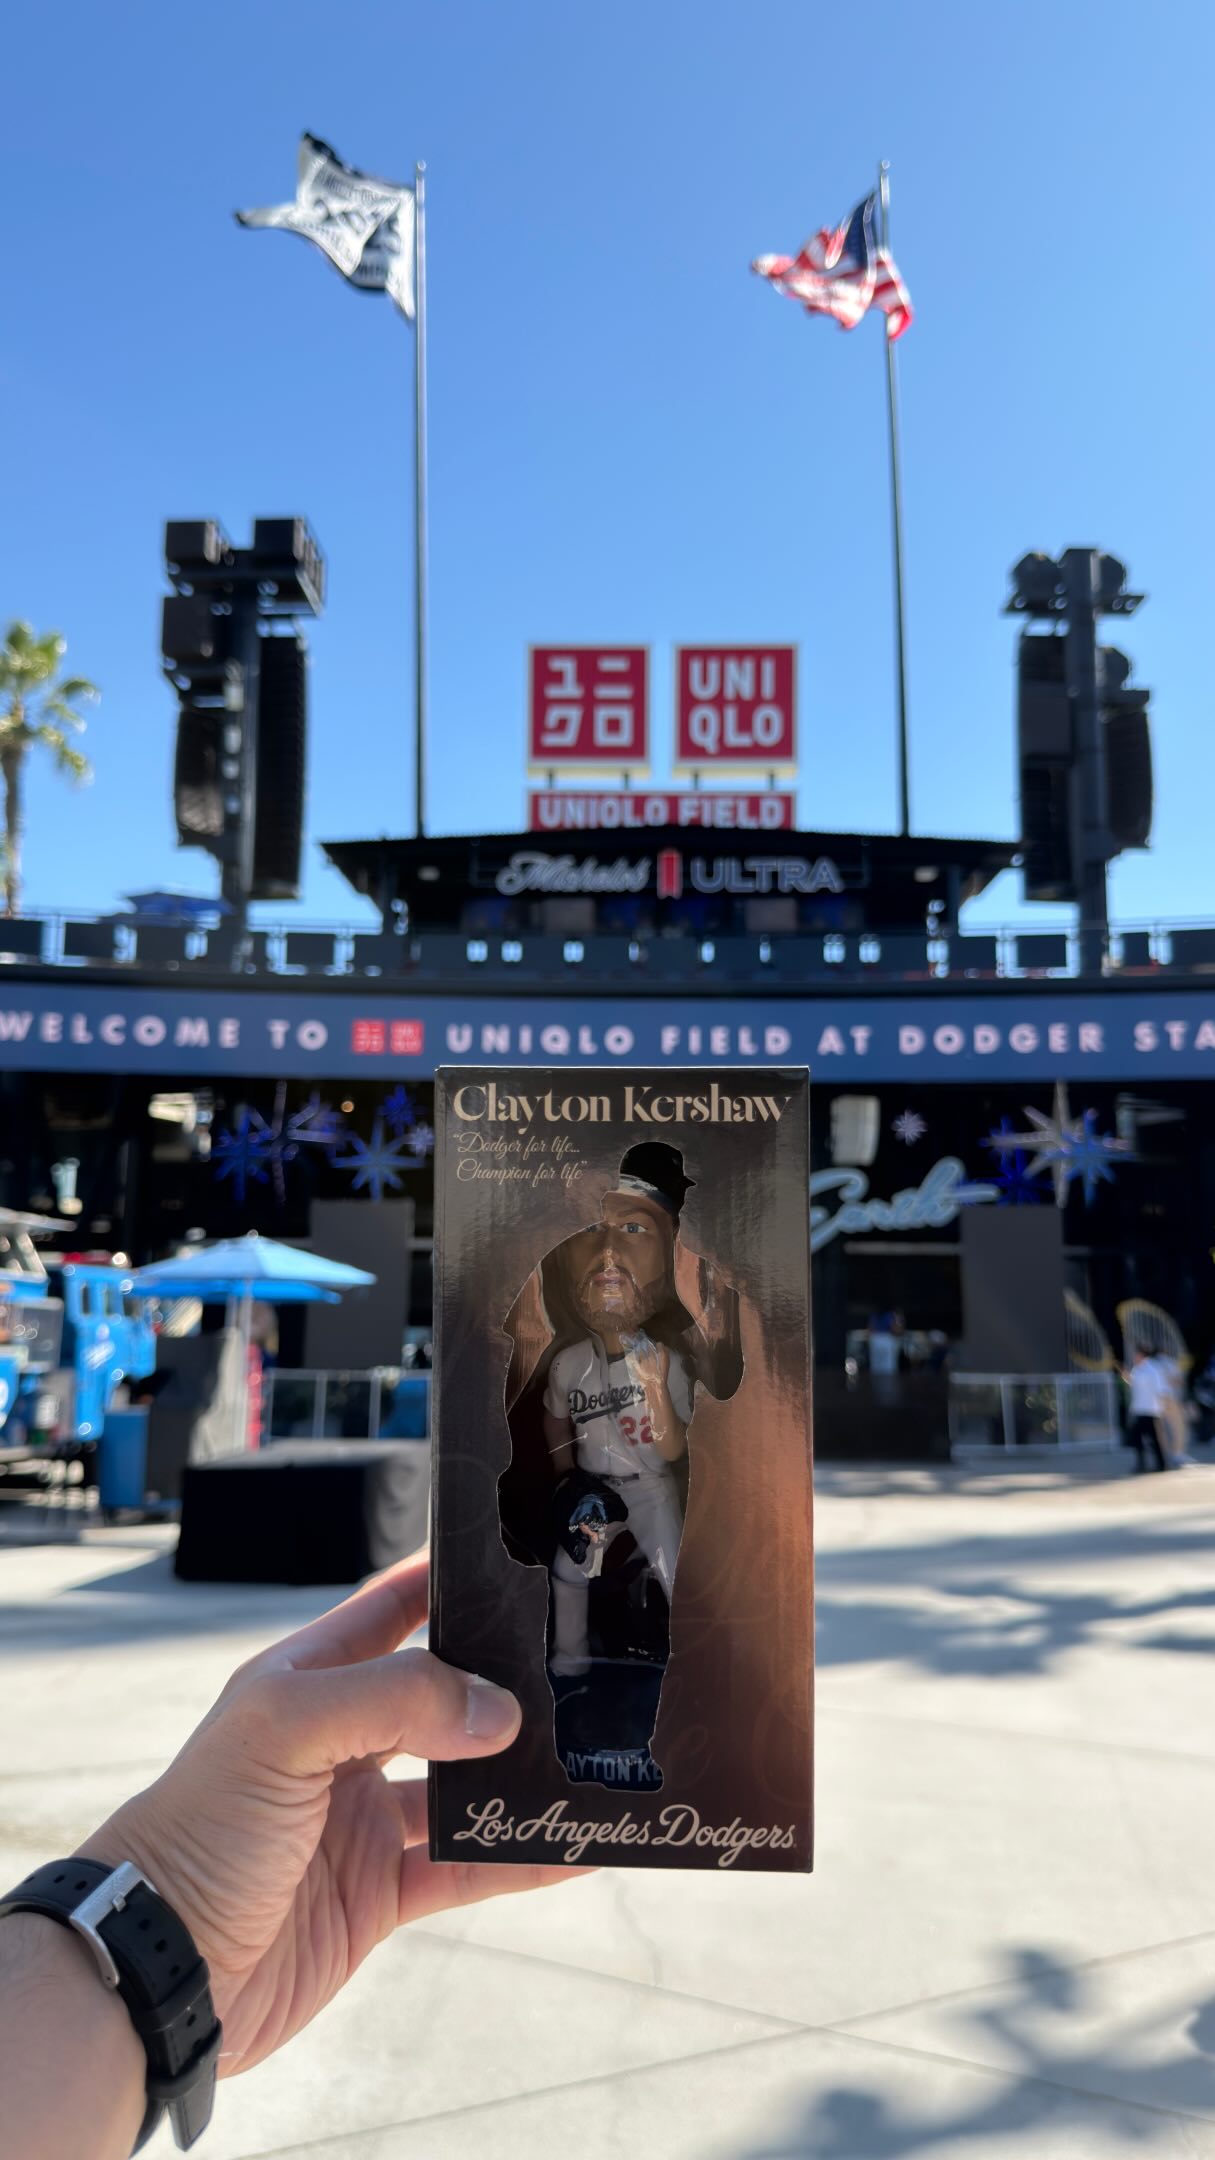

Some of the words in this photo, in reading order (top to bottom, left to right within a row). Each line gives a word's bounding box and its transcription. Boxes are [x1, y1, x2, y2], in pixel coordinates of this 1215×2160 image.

[688, 656, 776, 700] UNI
[687, 703, 785, 755] QLO
[677, 796, 785, 829] FIELD
[689, 854, 846, 894] ULTRA
[0, 1010, 241, 1050] WELCOME
[267, 1019, 329, 1051] TO
[445, 1022, 636, 1056] UNIQLO
[660, 1024, 793, 1056] FIELD
[816, 1024, 873, 1056] AT
[898, 1021, 1107, 1056] DODGER
[453, 1082, 612, 1135] Clayton
[623, 1083, 792, 1123] Kershaw
[522, 1135, 548, 1161] for
[456, 1158, 532, 1186] Champion
[531, 1162, 556, 1188] for
[619, 1416, 655, 1447] 22
[453, 1798, 514, 1847] Los
[515, 1800, 652, 1863] Angeles
[651, 1804, 796, 1867] Dodgers
